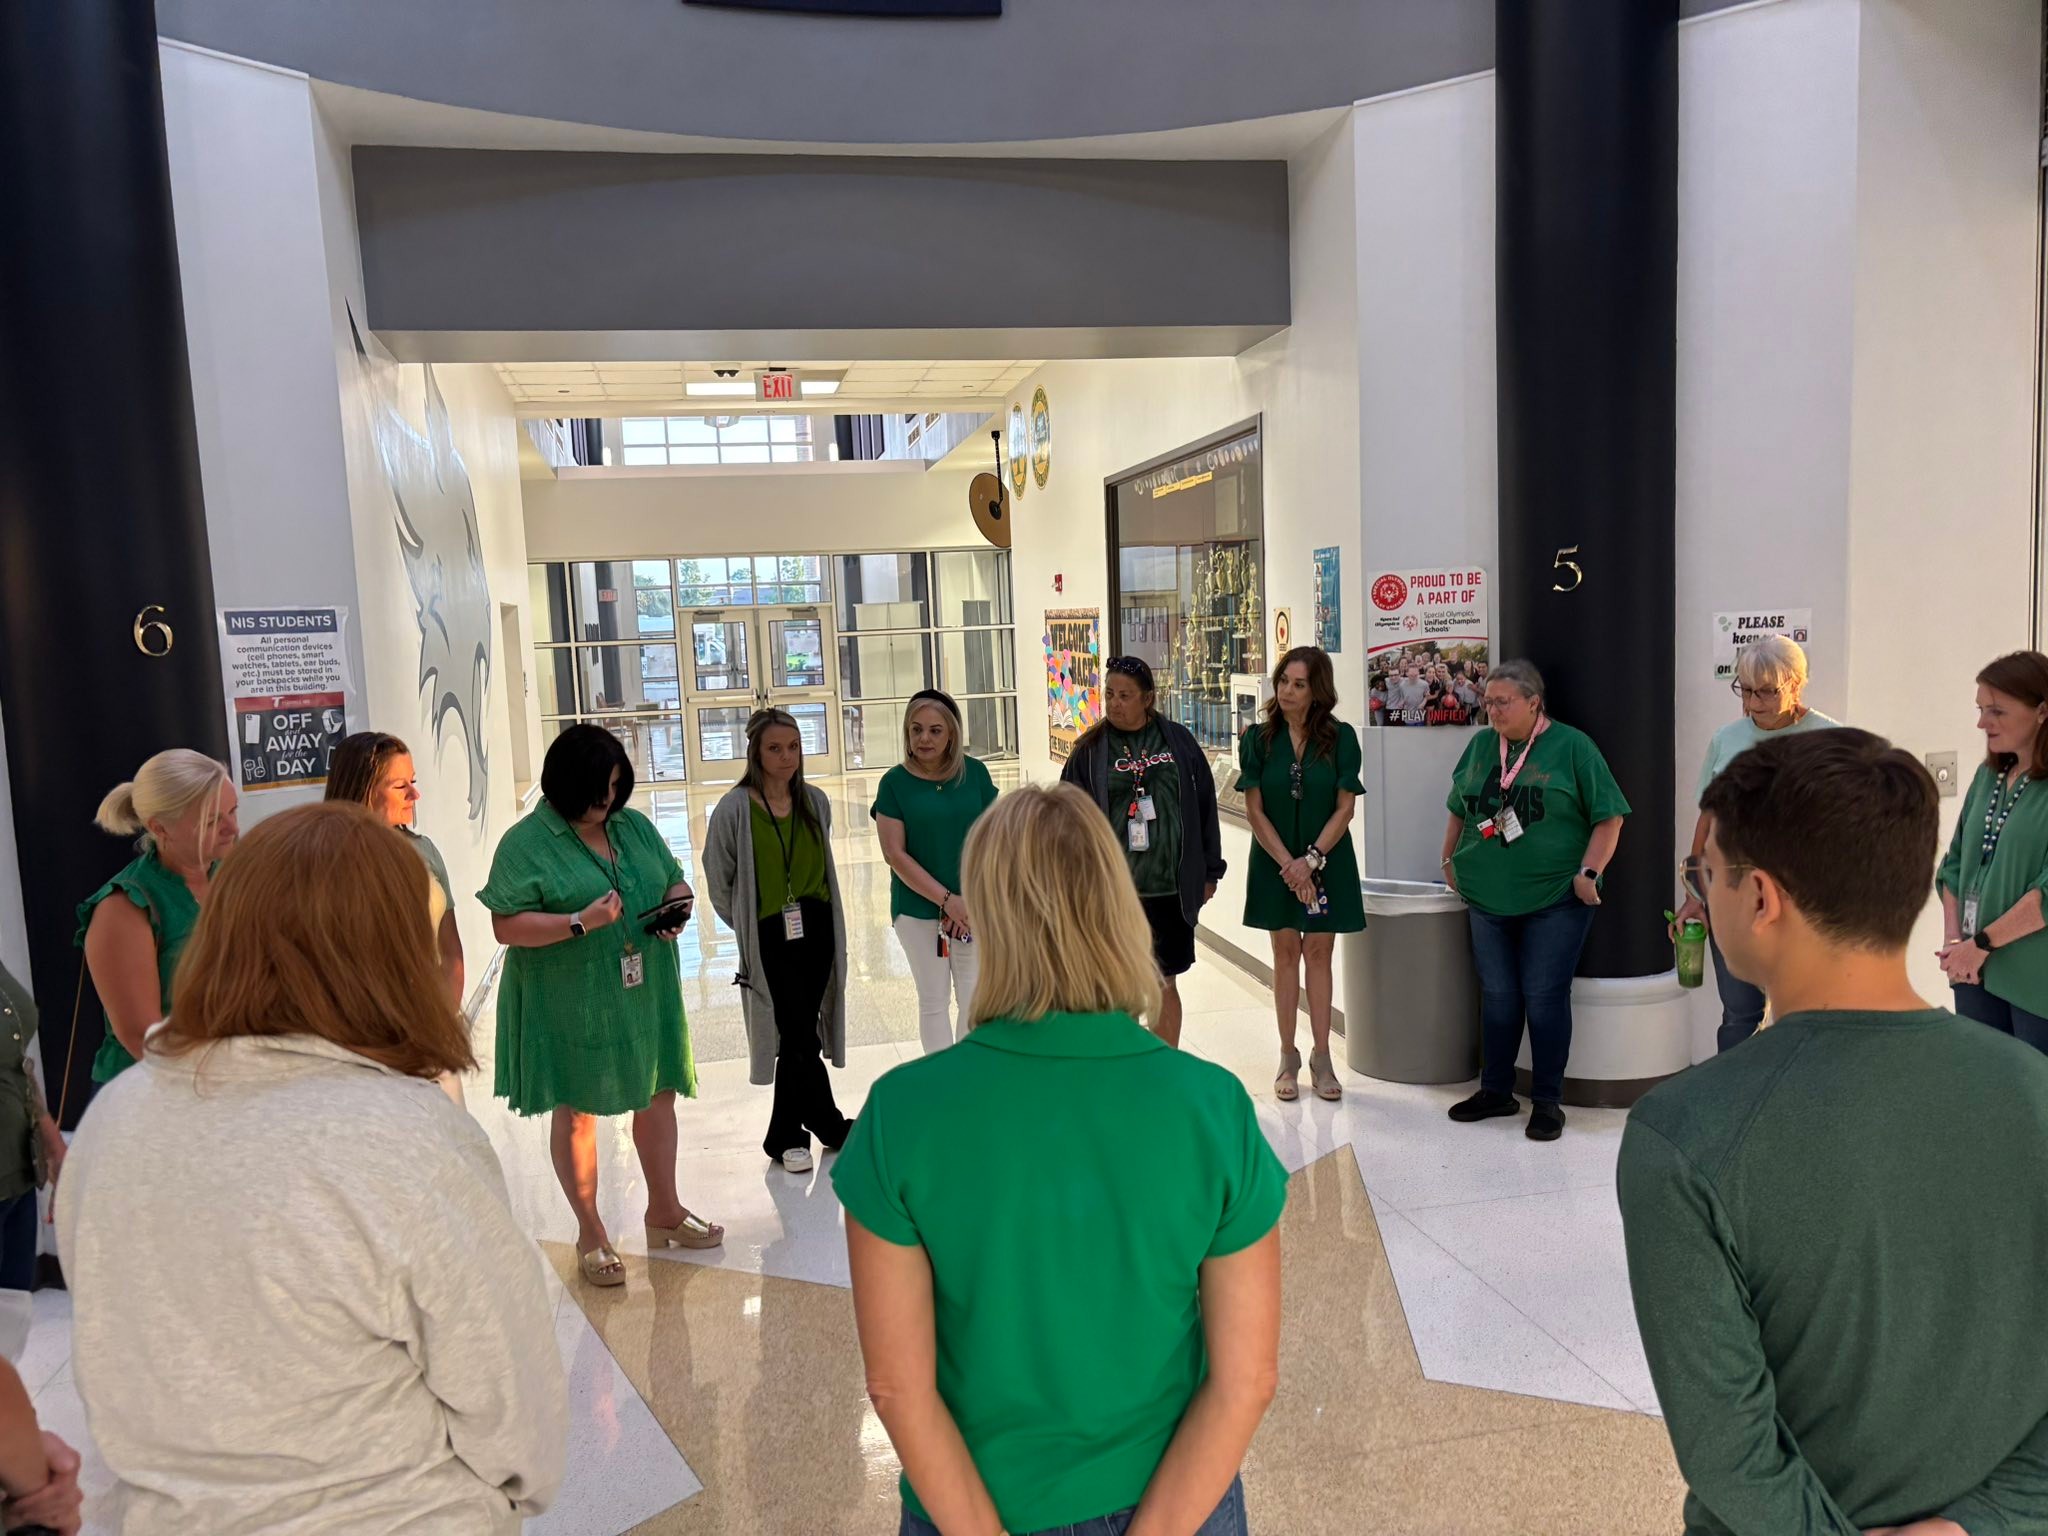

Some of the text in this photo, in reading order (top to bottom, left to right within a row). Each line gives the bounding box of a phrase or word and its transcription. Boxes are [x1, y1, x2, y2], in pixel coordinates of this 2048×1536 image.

[763, 374, 793, 398] EXIT
[1553, 544, 1582, 592] 5
[1410, 572, 1481, 588] PROUD TO BE
[1417, 590, 1475, 605] A PART OF
[231, 615, 331, 629] NIS STUDENTS
[1737, 616, 1785, 629] PLEASE
[134, 605, 173, 656] 6
[274, 636, 309, 645] personal
[1050, 623, 1091, 653] WELCOME
[237, 643, 333, 653] communication devices
[267, 653, 300, 662] phones,
[301, 651, 324, 659] smart
[232, 662, 269, 670] watches,
[271, 660, 301, 668] tablets,
[318, 659, 340, 667] buds,
[1717, 665, 1731, 674] on
[242, 669, 260, 678] etc.)
[262, 669, 283, 677] must
[285, 667, 295, 675] be
[297, 666, 323, 675] stored
[1072, 656, 1094, 687] BACK
[235, 680, 254, 688] your
[256, 676, 300, 686] backpacks
[325, 675, 340, 683] you
[276, 684, 291, 692] this
[293, 682, 328, 691] building.
[273, 713, 312, 730] OFF
[284, 726, 301, 736] and
[266, 732, 322, 752] AWAY
[282, 748, 308, 761] for the
[276, 757, 316, 776] DAY
